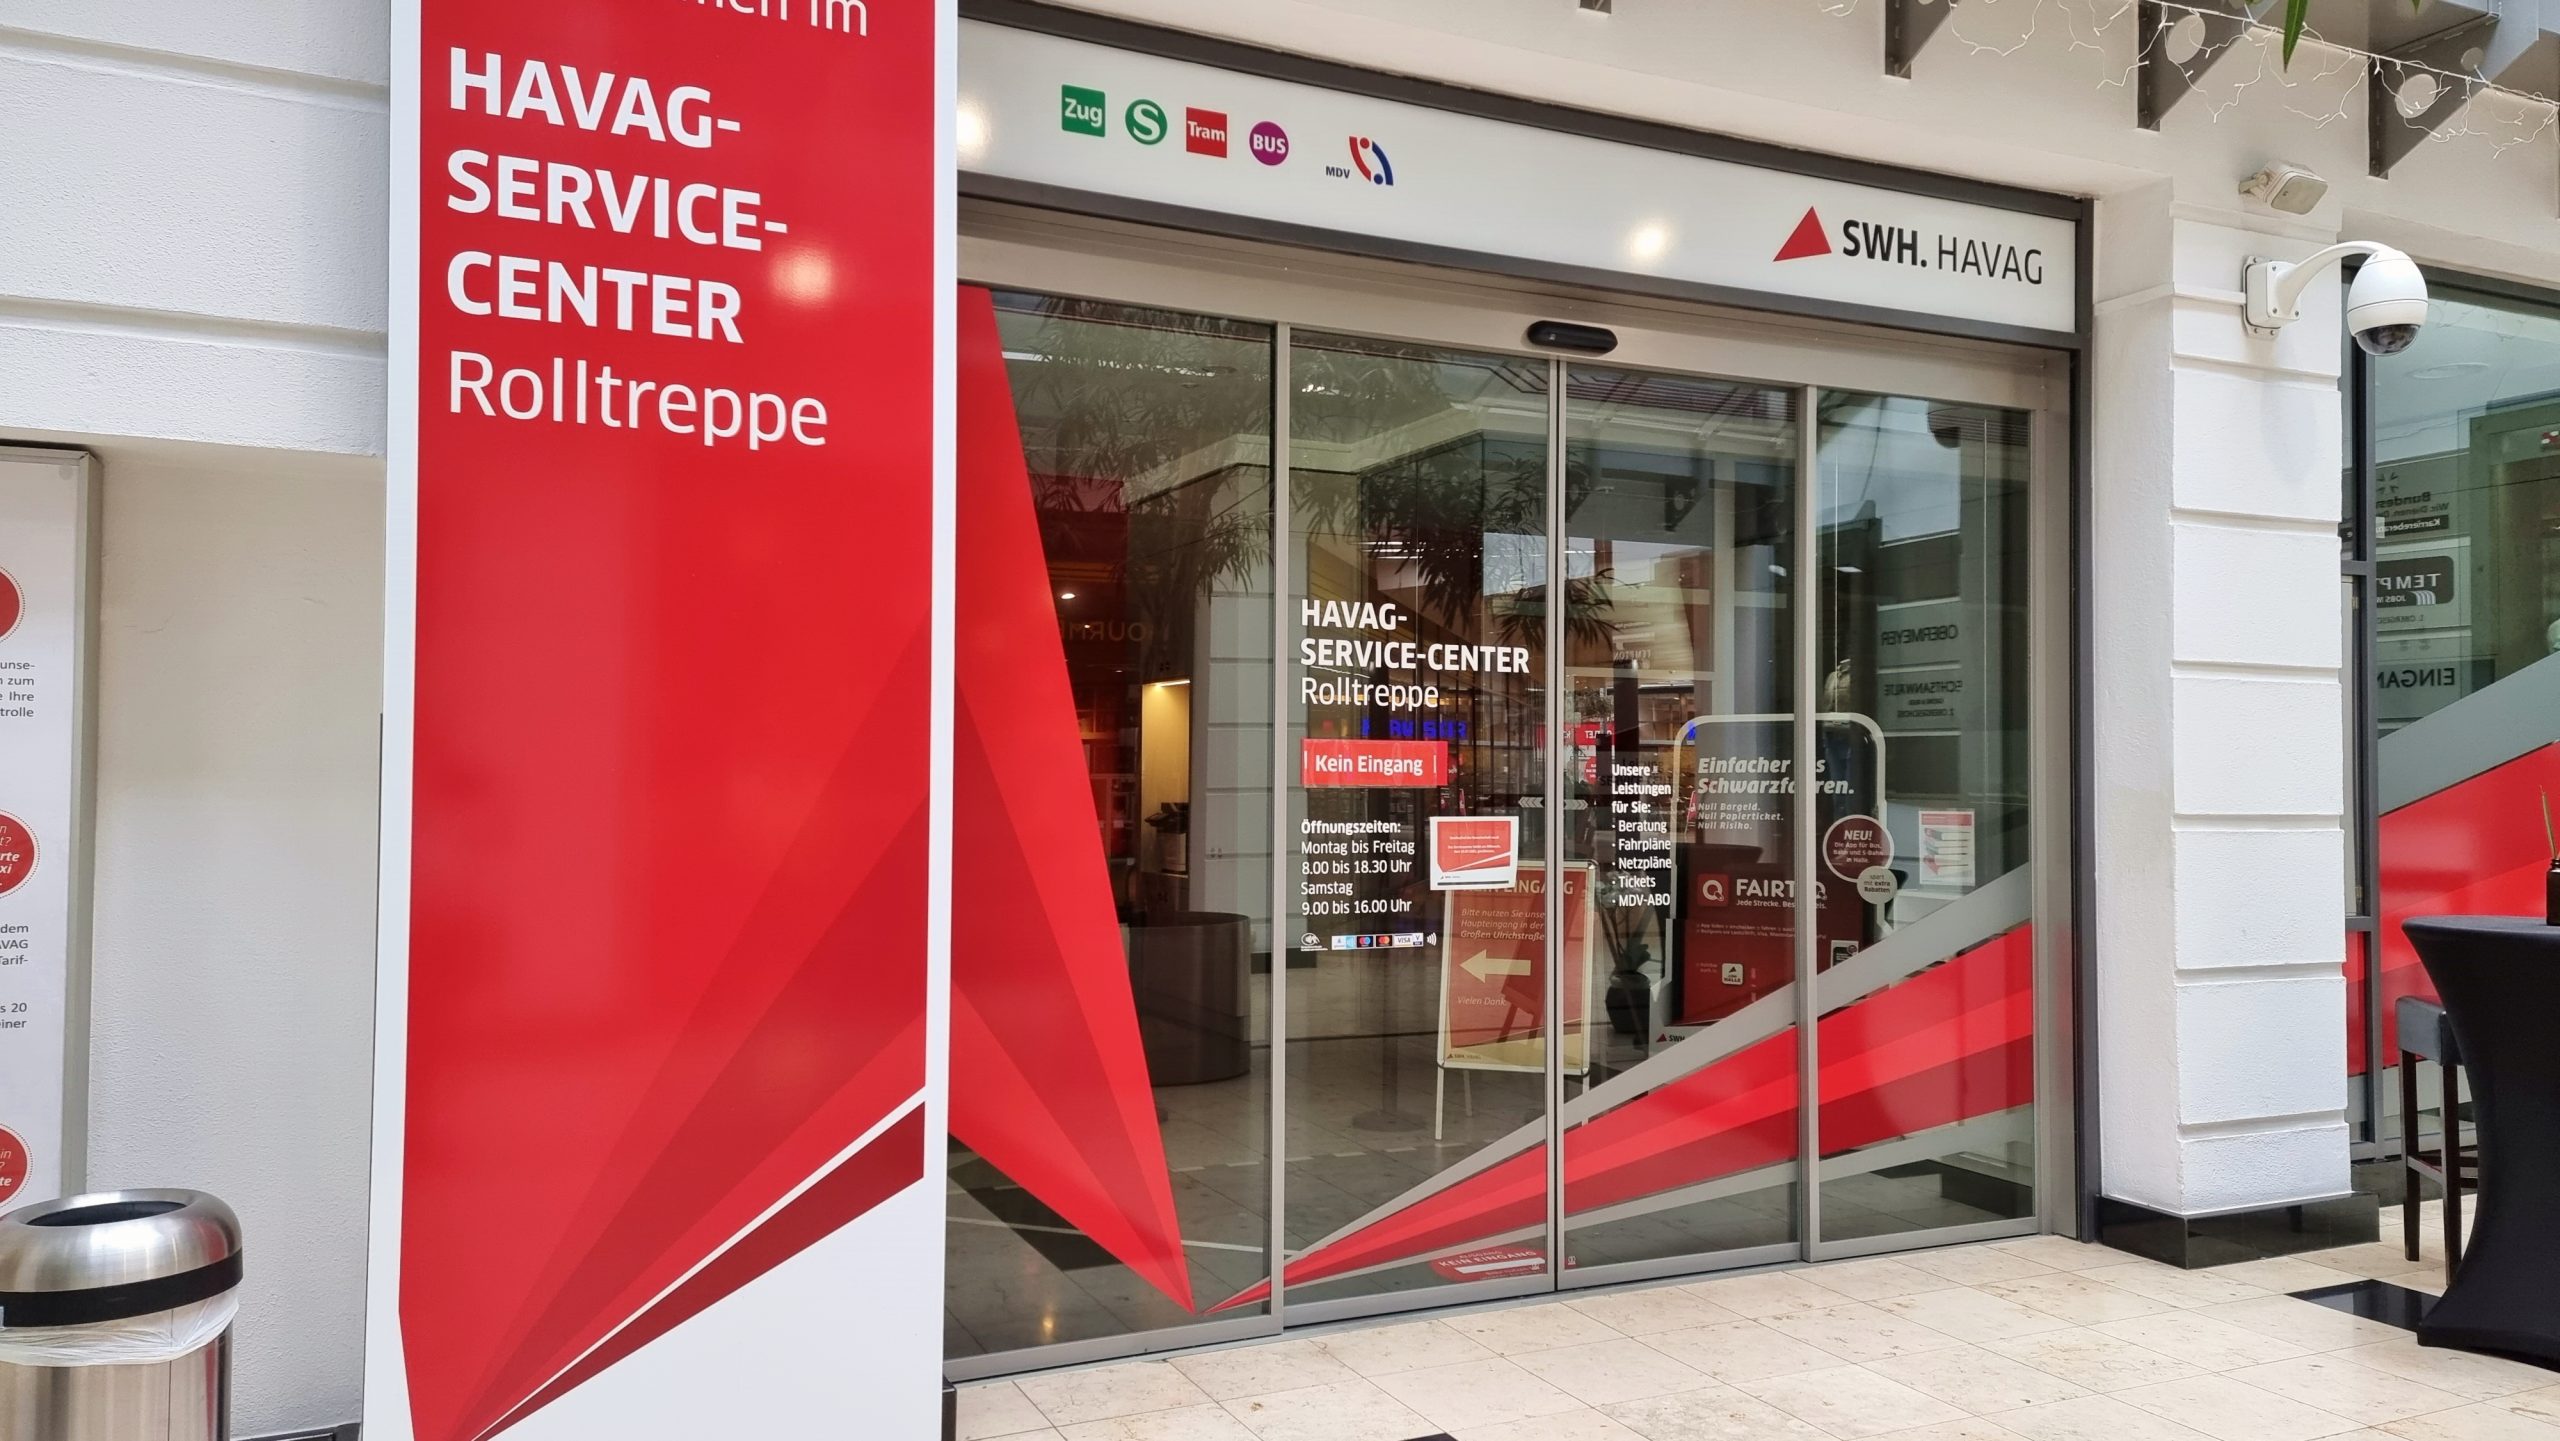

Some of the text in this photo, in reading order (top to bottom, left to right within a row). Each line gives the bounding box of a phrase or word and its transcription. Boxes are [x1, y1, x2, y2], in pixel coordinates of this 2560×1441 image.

[450, 47, 741, 149] HAVAG-
[1064, 97, 1102, 128] Zug
[1132, 102, 1160, 143] S
[1187, 121, 1226, 142] Tram
[1253, 133, 1286, 155] BUS
[1325, 165, 1350, 180] MDV
[447, 149, 788, 252] SERVICE-
[1842, 219, 2042, 285] SWH. HAVAG
[447, 251, 744, 344] CENTER
[450, 350, 828, 451] Rolltreppe
[1301, 599, 1407, 631] HAVAG-
[1300, 638, 1530, 674] SERVICE-CENTER
[9, 691, 35, 701] Ihre
[1301, 677, 1439, 711] Rolltreppe
[0, 707, 34, 717] trolle
[1315, 754, 1423, 776] Kein Eingang
[1612, 764, 1650, 776] Unsere
[1698, 757, 1791, 773] Einfacher
[1612, 783, 1671, 796] Leistungen
[1698, 777, 1855, 794] Schwarzfaren.
[1612, 801, 1651, 813] für Sie:
[1698, 803, 1760, 811] Null Bargeld.
[1698, 812, 1784, 821] Null Papierticket.
[1301, 819, 1401, 834] Öffnungszeiten:
[1619, 820, 1667, 834] Beratung
[1698, 821, 1752, 830] Null Risiko.
[1844, 830, 1873, 840] NEU!
[1301, 839, 1415, 857] Montag bis Freitag
[1619, 838, 1671, 852] Fahrpläne
[0, 852, 20, 861] rte
[1619, 857, 1672, 871] Netzpläne
[0, 864, 12, 873] xi
[1302, 859, 1412, 875] 8.00 bis 18.30 Uhr
[1301, 881, 1353, 896] Samstag
[1619, 876, 1656, 888] Tickets
[1736, 879, 1827, 900] FAIRTQ
[1619, 893, 1670, 906] MDV-ABO
[1302, 899, 1412, 916] 9.00 bis 16.00 Uhr
[1462, 909, 1479, 917] Bitte
[1482, 910, 1509, 918] nutzen
[1512, 909, 1523, 918] Sie
[1462, 920, 1544, 930] Haupteingang in der
[1461, 930, 1490, 939] Großen
[11, 1003, 27, 1013] 20
[1458, 996, 1482, 1005] Vielen
[0, 1019, 27, 1029] iner
[1438, 1257, 1473, 1267] KEIN
[1475, 1251, 1537, 1262] EINGANG
